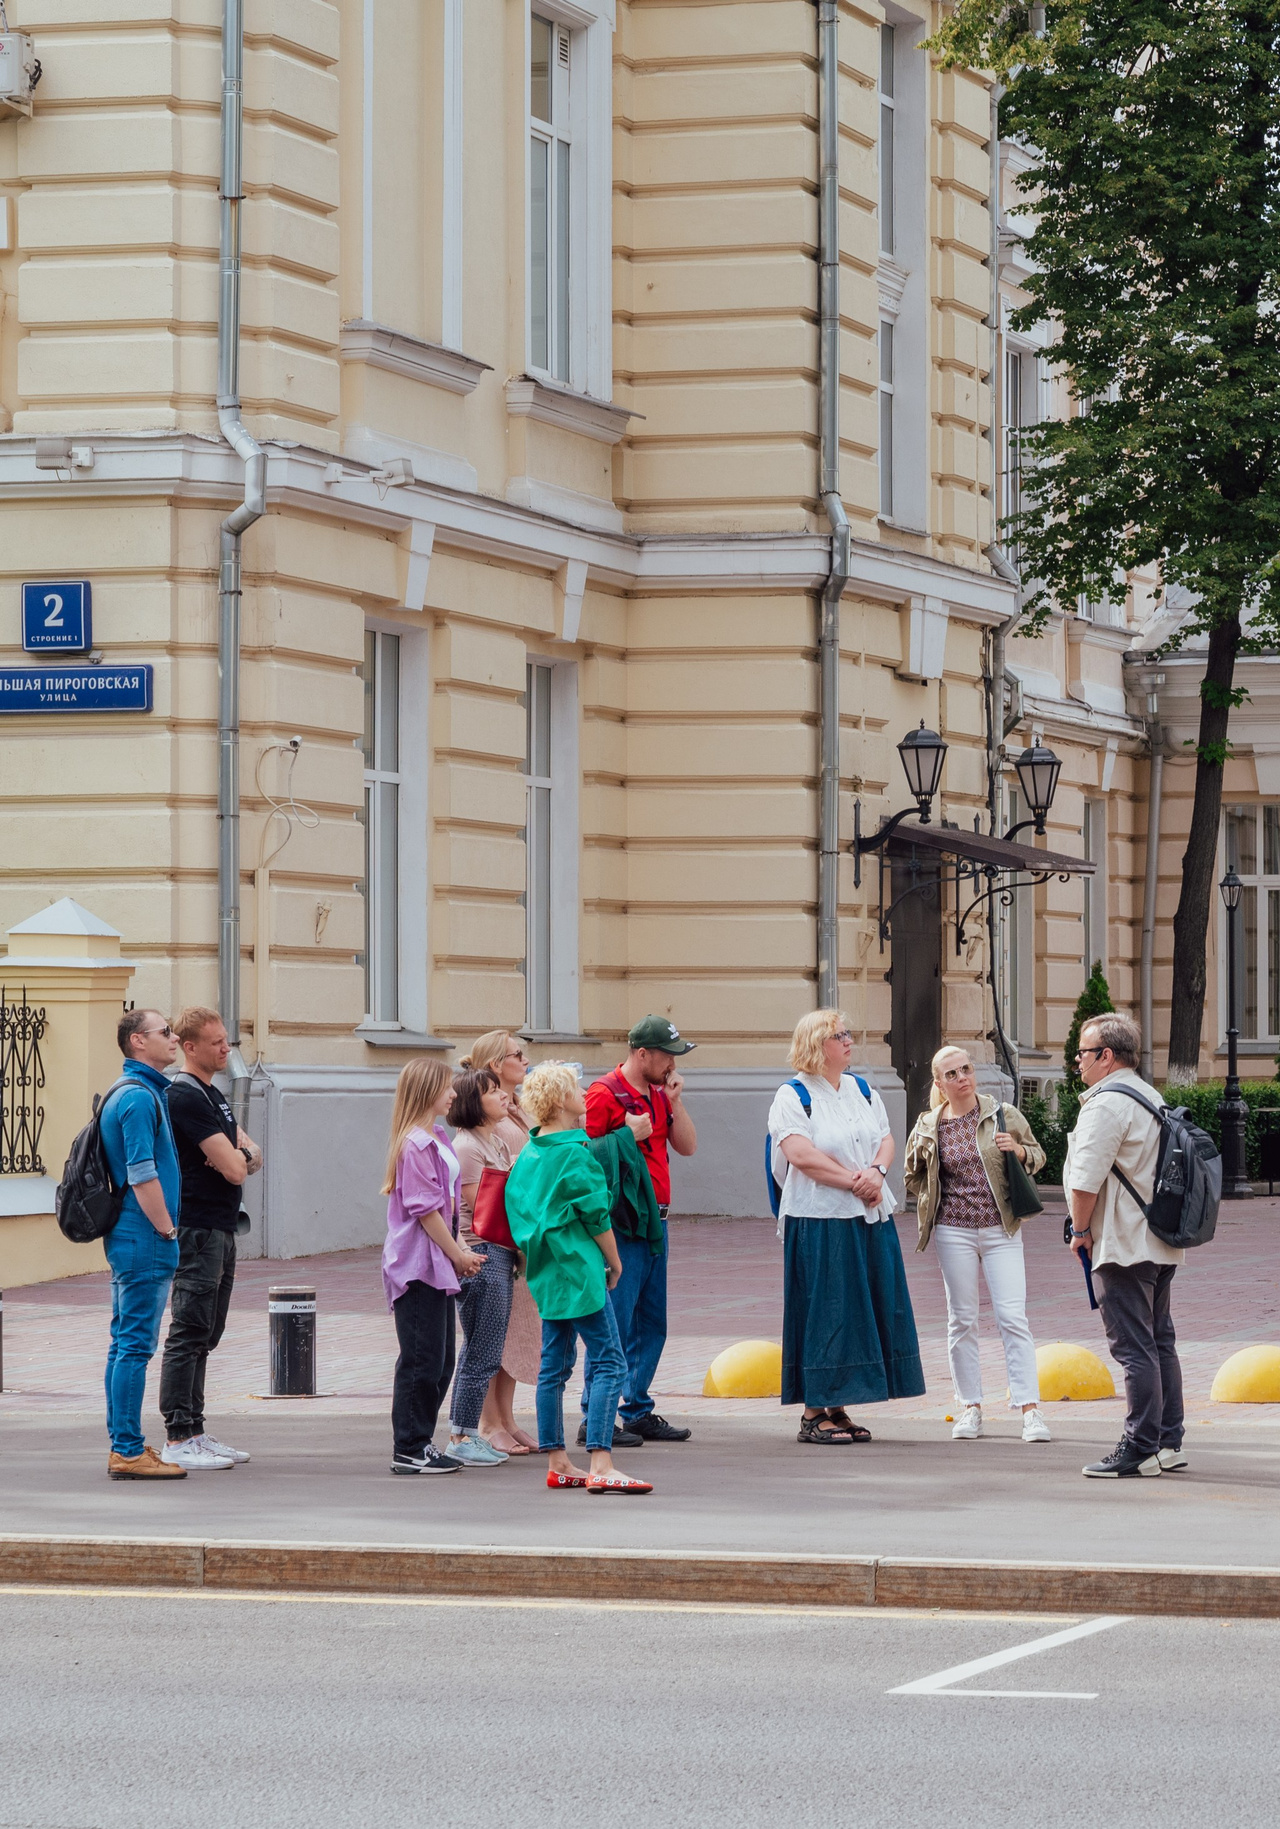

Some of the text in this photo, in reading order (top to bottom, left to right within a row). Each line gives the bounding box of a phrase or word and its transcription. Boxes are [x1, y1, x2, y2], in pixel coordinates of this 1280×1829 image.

[43, 593, 64, 627] 2
[45, 676, 139, 690] ПИРОГОВСКАЯ
[40, 693, 77, 702] УЛИЦА
